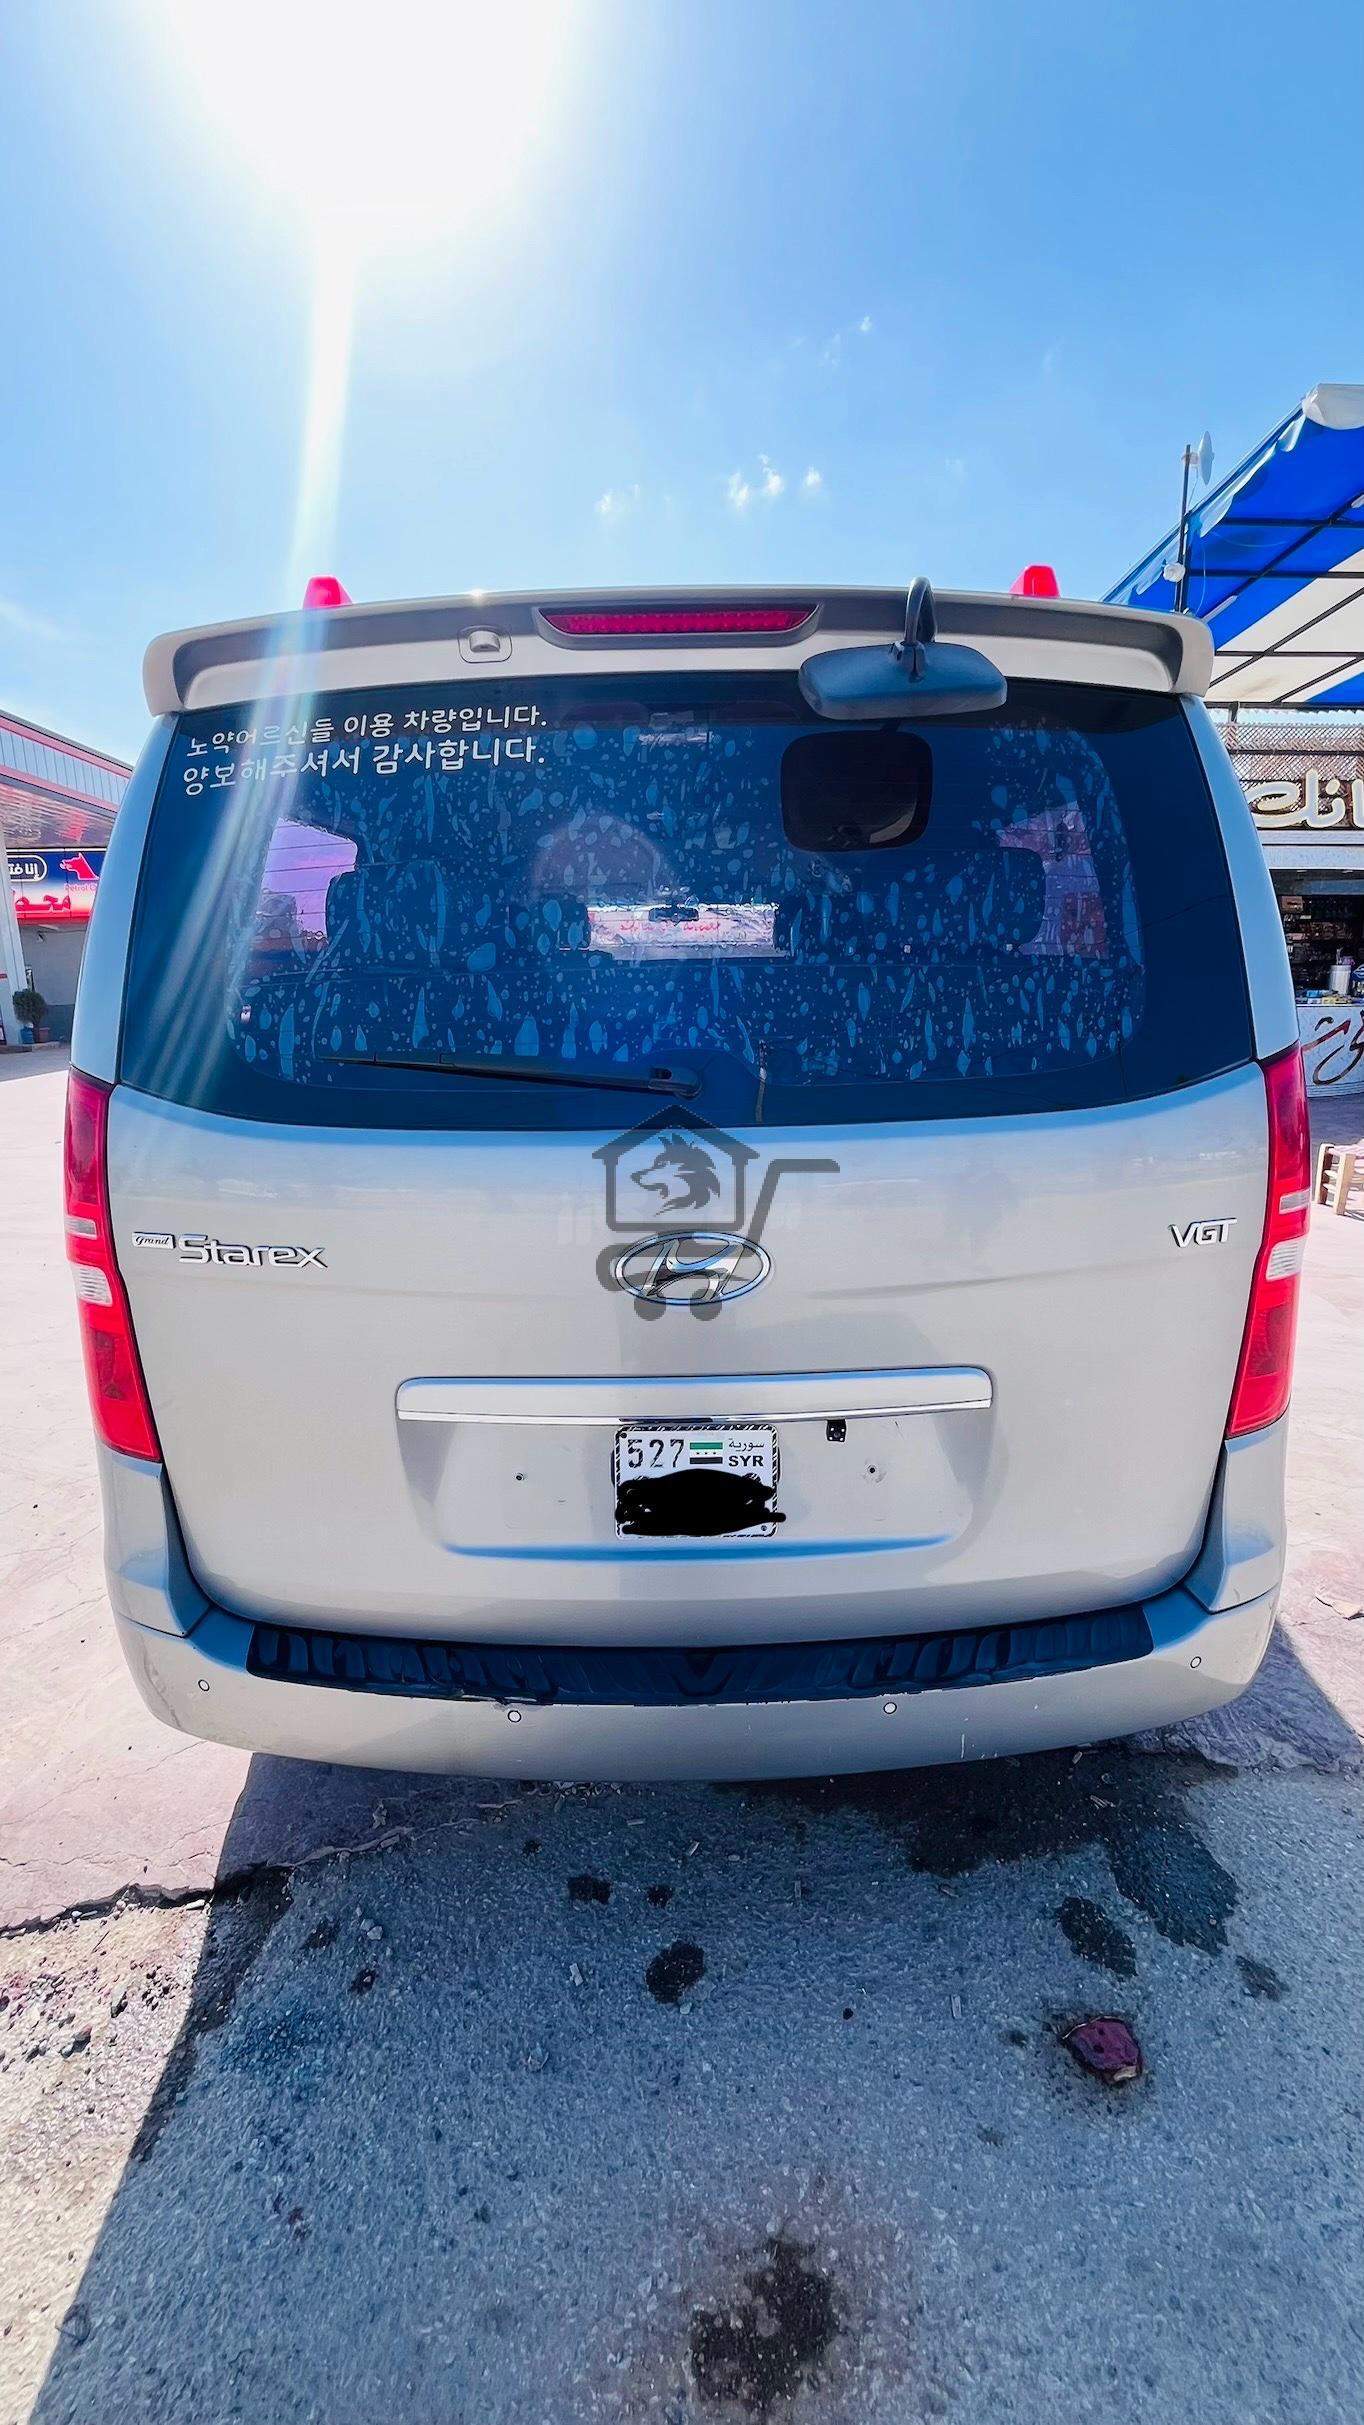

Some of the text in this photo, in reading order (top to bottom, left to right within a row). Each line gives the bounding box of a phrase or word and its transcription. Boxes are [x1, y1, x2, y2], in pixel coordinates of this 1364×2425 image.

[187, 704, 547, 757] 노약어르신들 이용 차량입니다.
[183, 735, 545, 796] 양보해주셔서 감사합니다.
[1167, 1217, 1238, 1248] VGT
[179, 1233, 328, 1269] Starex
[627, 1438, 685, 1468] 527
[728, 1438, 765, 1451] سورية
[728, 1455, 764, 1467] SYR
